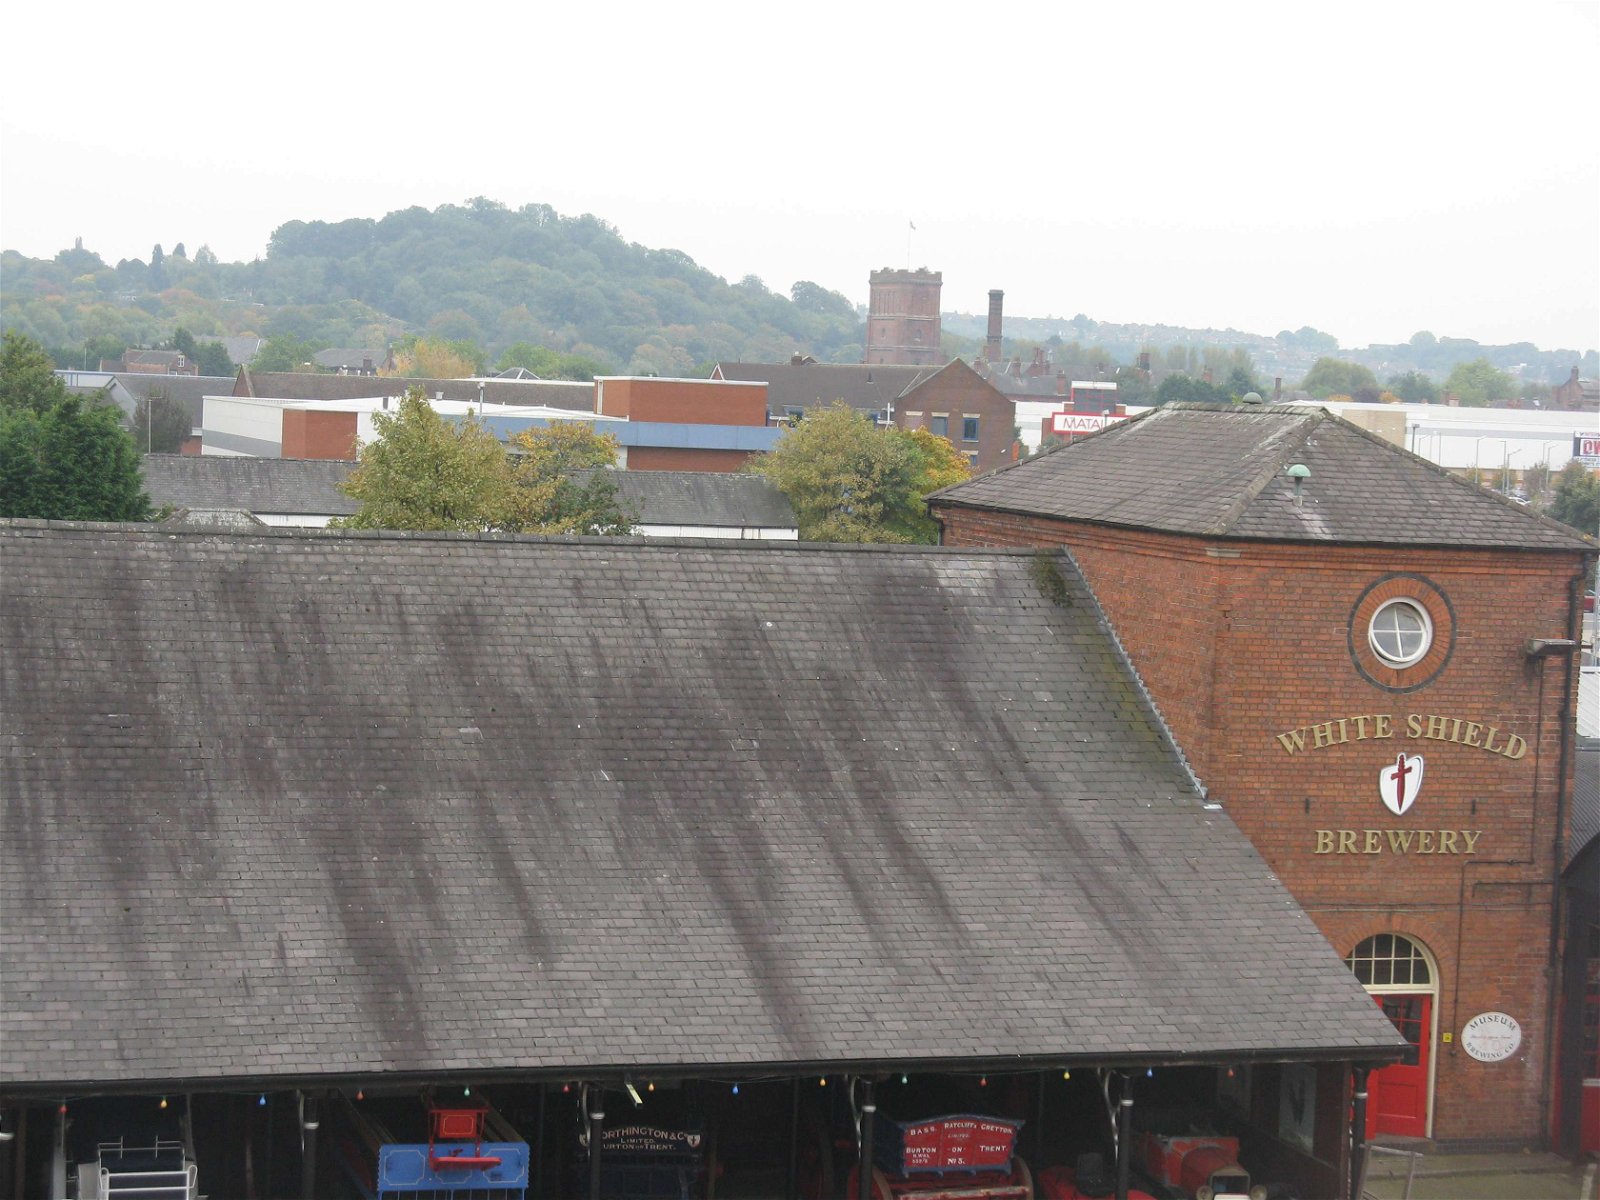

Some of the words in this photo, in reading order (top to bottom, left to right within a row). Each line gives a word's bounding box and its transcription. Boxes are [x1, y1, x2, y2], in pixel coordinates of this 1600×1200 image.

[1276, 714, 1393, 756] WHITE
[1406, 713, 1527, 760] SHIELD
[1314, 829, 1482, 854] BREWERY
[1470, 1015, 1516, 1031] MUSEUM
[1466, 1042, 1503, 1058] BREWING
[602, 1126, 668, 1140] ORTHINGTON
